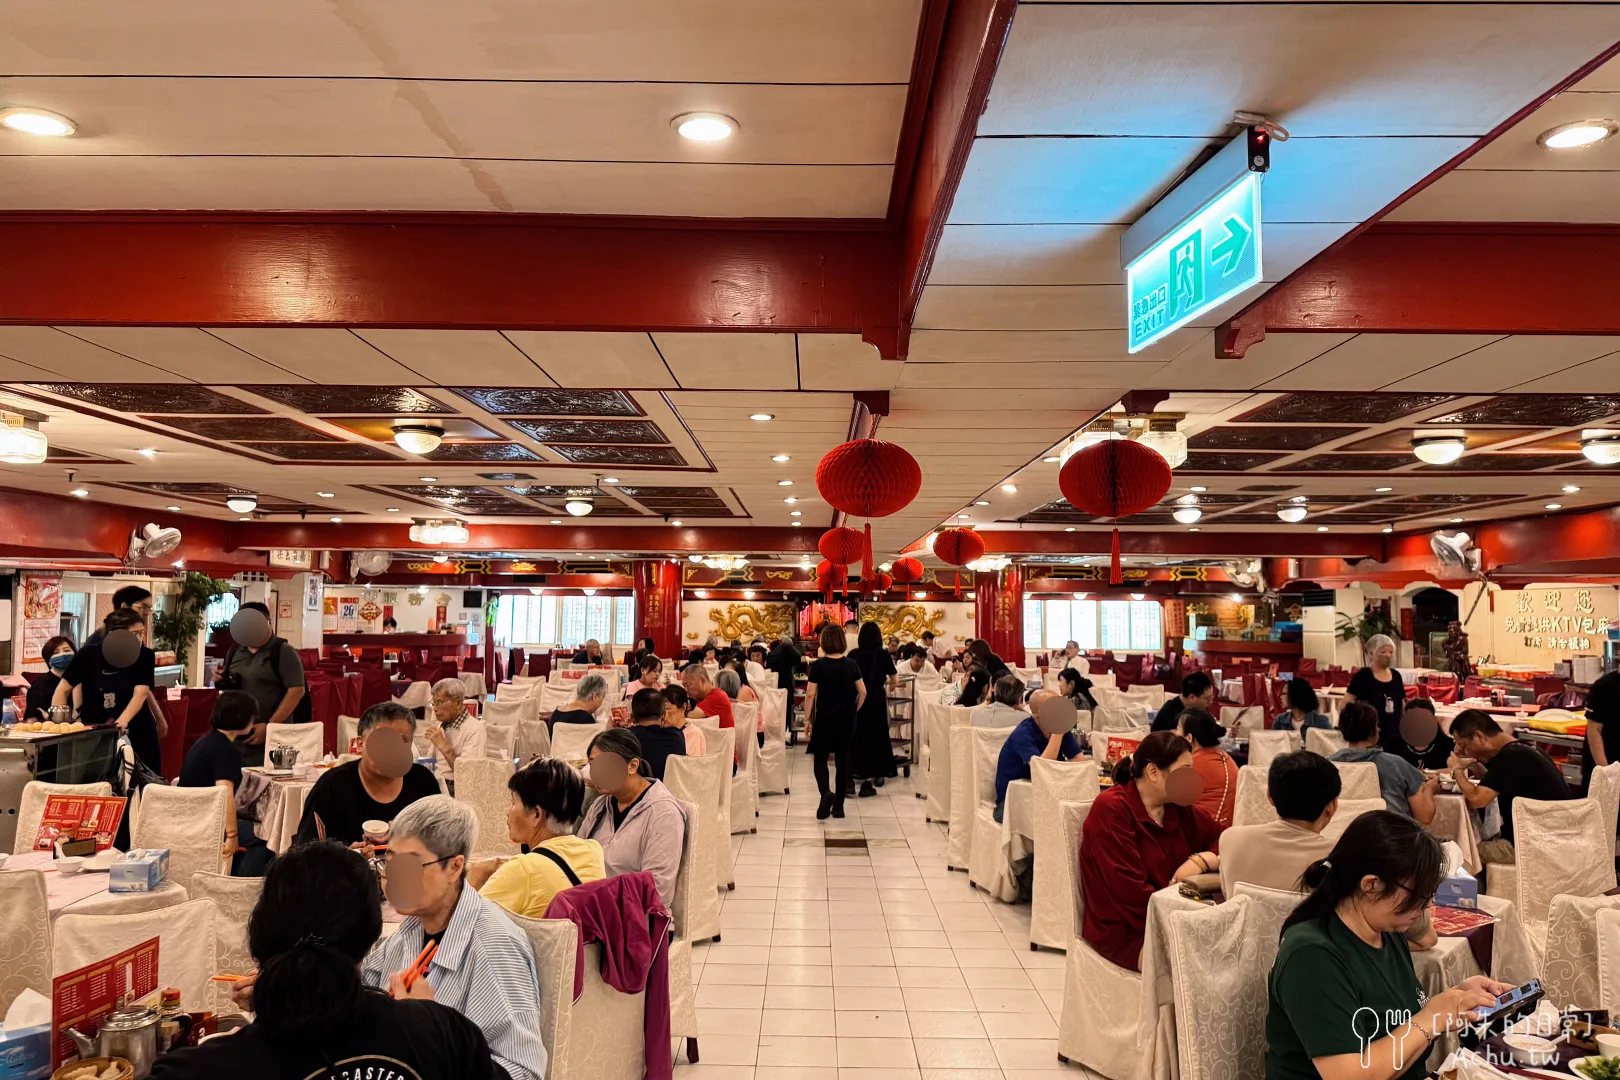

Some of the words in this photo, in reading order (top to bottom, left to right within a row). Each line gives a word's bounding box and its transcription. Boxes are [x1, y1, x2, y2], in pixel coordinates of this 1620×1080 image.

[1133, 285, 1166, 321] 緊急出口
[1135, 307, 1164, 338] EXIT
[343, 604, 355, 617] 20
